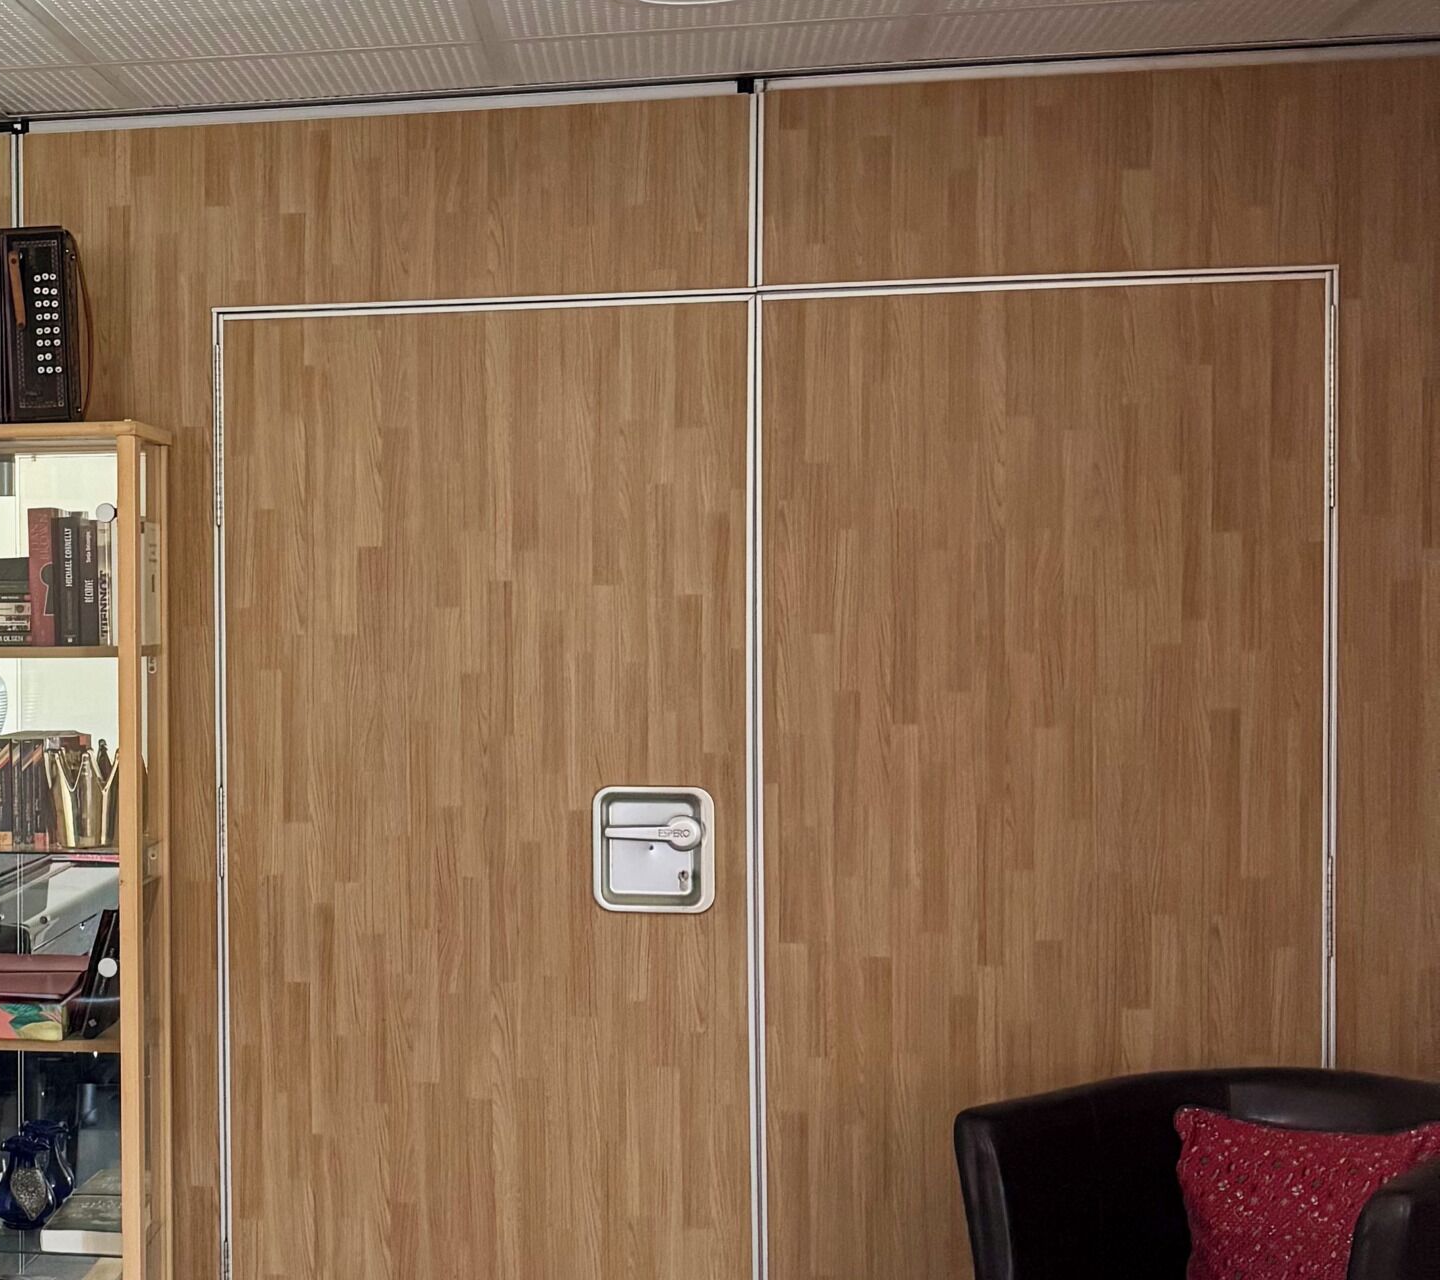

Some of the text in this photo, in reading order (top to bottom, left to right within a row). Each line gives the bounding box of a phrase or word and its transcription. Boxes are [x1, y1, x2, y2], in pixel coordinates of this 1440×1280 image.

[64, 528, 72, 558] CONNELLY
[65, 560, 73, 587] MICHAEL
[658, 829, 690, 838] ESPERO
